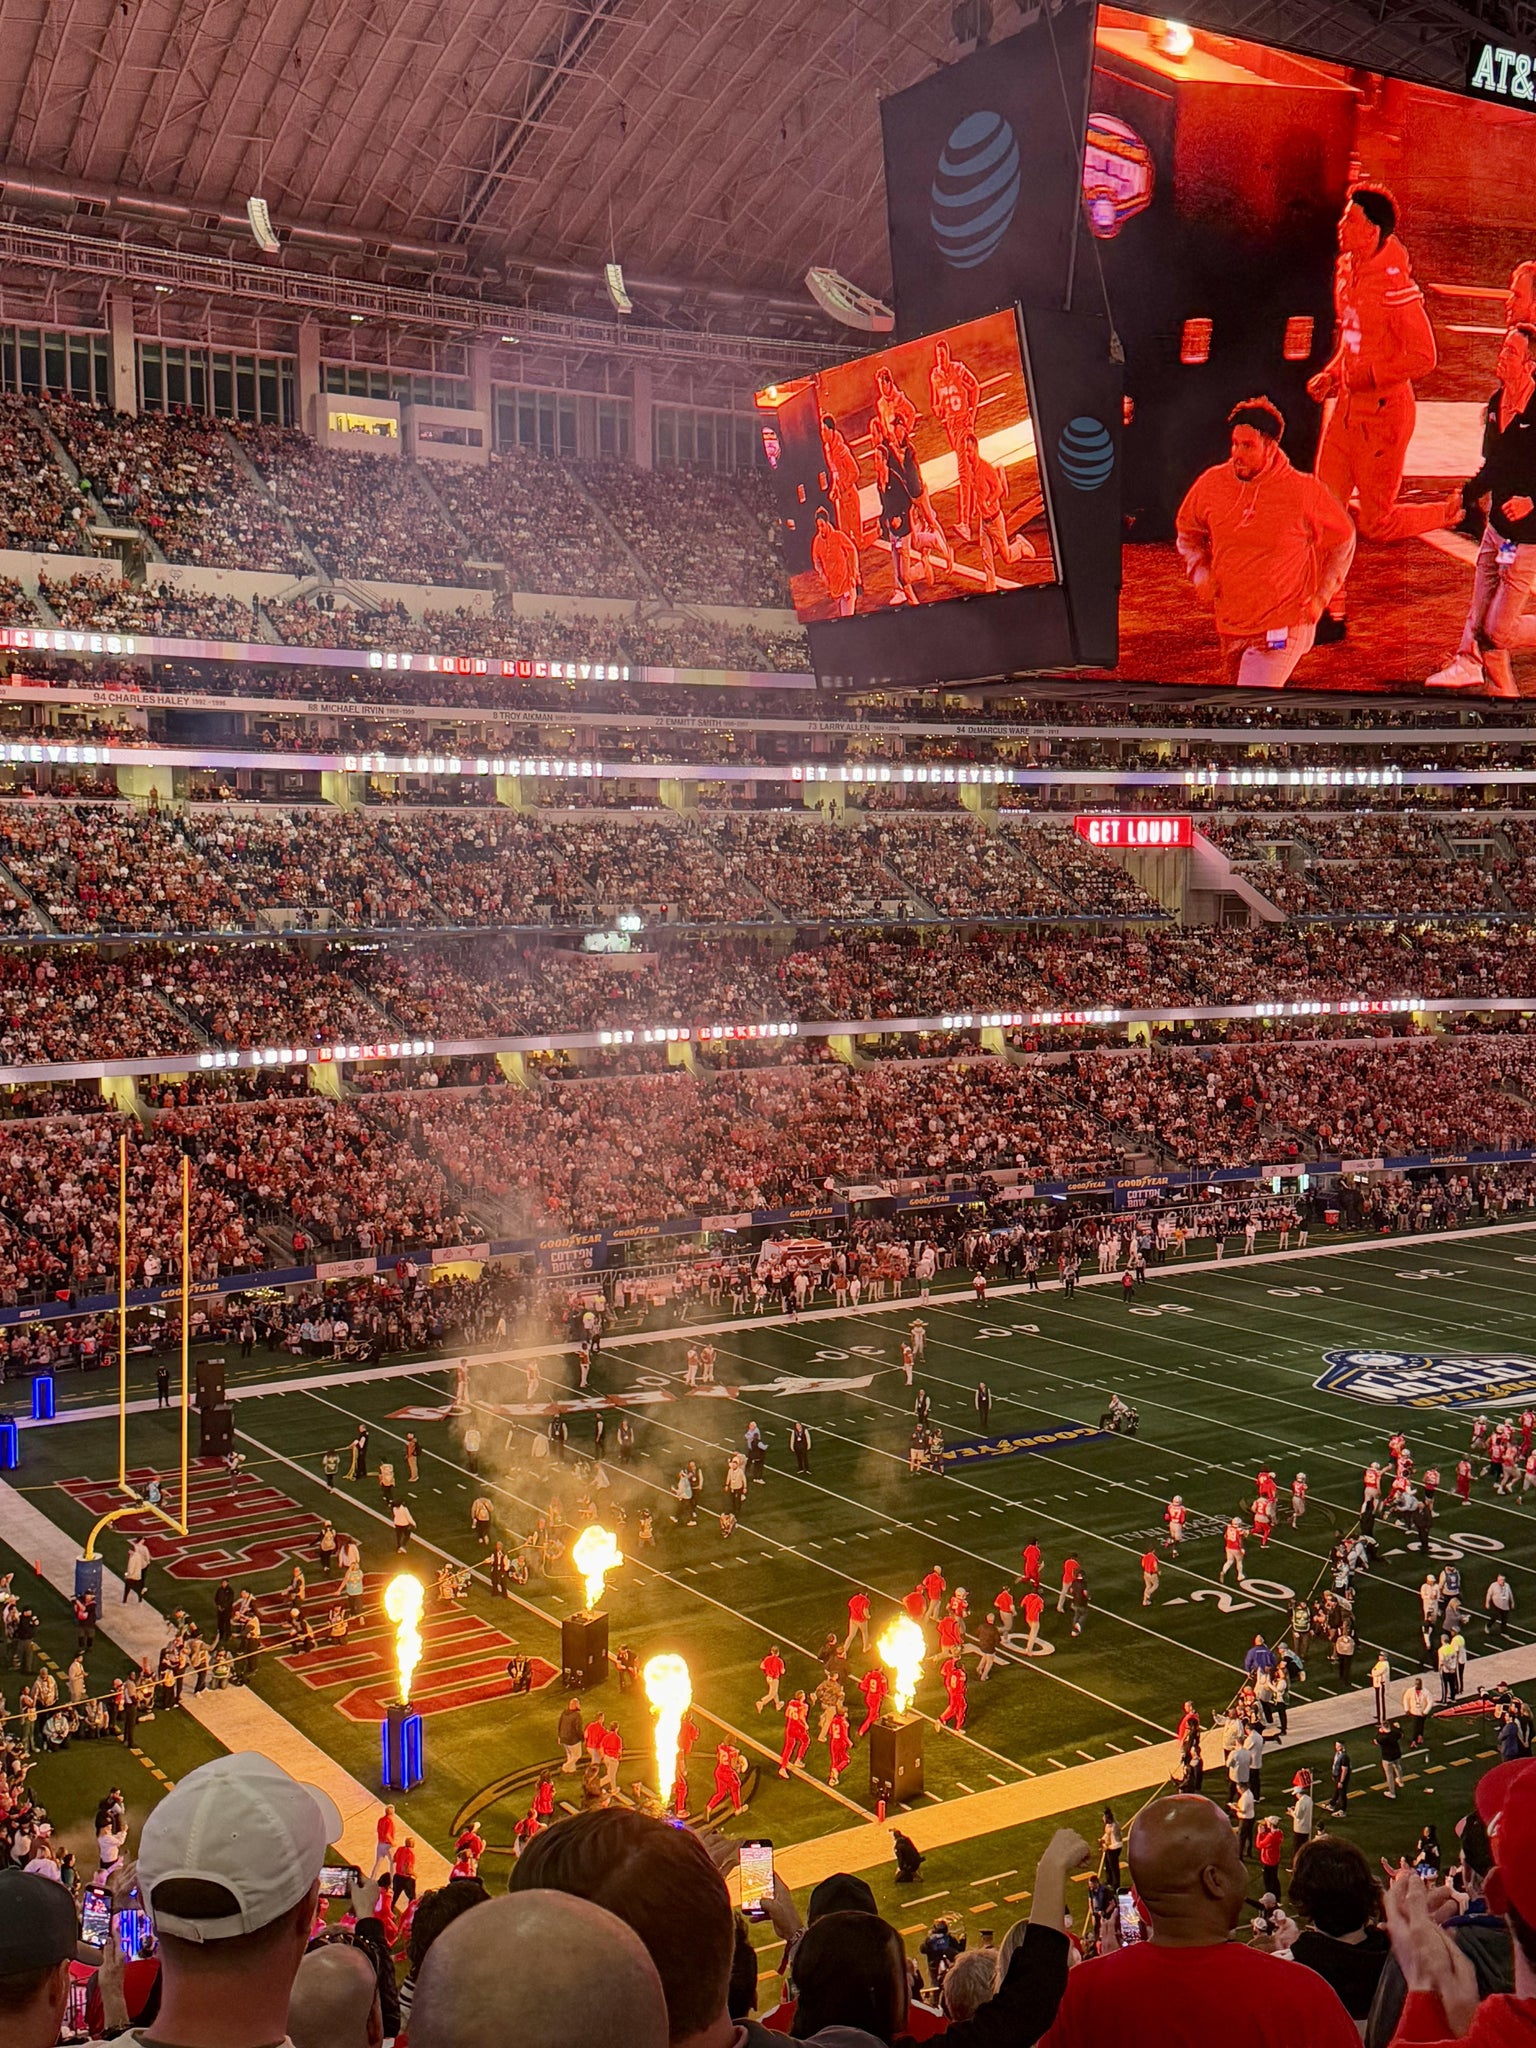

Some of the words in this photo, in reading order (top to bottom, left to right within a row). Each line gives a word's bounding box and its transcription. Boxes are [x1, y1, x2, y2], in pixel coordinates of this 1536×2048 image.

[1471, 44, 1536, 102] AT&
[0, 631, 135, 654] CKEYES!
[369, 652, 413, 669] GET
[428, 655, 487, 675] LOUD
[502, 659, 630, 681] BUCKEYES!
[108, 693, 156, 704] CHARLES
[157, 695, 190, 706] HALEY
[320, 704, 360, 713] MICHAEL
[361, 706, 385, 715] IRVIN
[500, 711, 521, 720] TROY
[523, 713, 553, 722] AIKMAN
[665, 718, 696, 727] EMMITT
[698, 719, 722, 728] SMITH
[819, 723, 845, 731] LARRY
[846, 723, 870, 732] ALLEN
[1009, 728, 1029, 736] WARE
[0, 745, 110, 765] KEYES!
[344, 757, 388, 772] GET
[403, 757, 462, 774] LOUD
[477, 759, 603, 777] BUCKEYES!
[791, 767, 828, 782] GET
[840, 767, 891, 783] LOUD
[903, 769, 1014, 784] BUCKEYES!
[1185, 771, 1220, 785] GET
[1231, 771, 1279, 785] LOUD
[1289, 771, 1403, 785] BUCKEYES!
[1089, 820, 1121, 843] GET
[1128, 820, 1180, 843] LOUD!
[1255, 1003, 1284, 1016] GET
[1292, 1003, 1331, 1015] LOUD
[1338, 999, 1426, 1015] BUCKEYES!
[942, 1016, 973, 1029] GET
[981, 1015, 1022, 1028] LOUD
[1031, 1010, 1121, 1026] BUCKEYES!
[600, 1030, 635, 1044] GET
[644, 1028, 691, 1042] LOUD
[698, 1023, 799, 1042] BUCKEYES!
[199, 1051, 241, 1068] GET
[252, 1048, 308, 1065] LOUD
[318, 1041, 435, 1062] BUCKEYES!
[1429, 1154, 1467, 1165] GOODYEAR
[1067, 1180, 1106, 1191] GOODYEAR
[1117, 1175, 1169, 1189] GOODYEAR
[909, 1194, 950, 1206] GOODYEAR
[1127, 1188, 1161, 1199] COTTON
[1127, 1199, 1146, 1208] BOW
[789, 1206, 833, 1218] GOODYEAR
[612, 1225, 660, 1238] GOODYEAR
[540, 1233, 602, 1250] GOODYEAR
[550, 1247, 593, 1262] COTTON
[160, 1281, 220, 1299] GOOYEAR
[1128, 1302, 1196, 1317] 50
[1406, 1532, 1505, 1561] 30
[1190, 1578, 1296, 1614] 20
